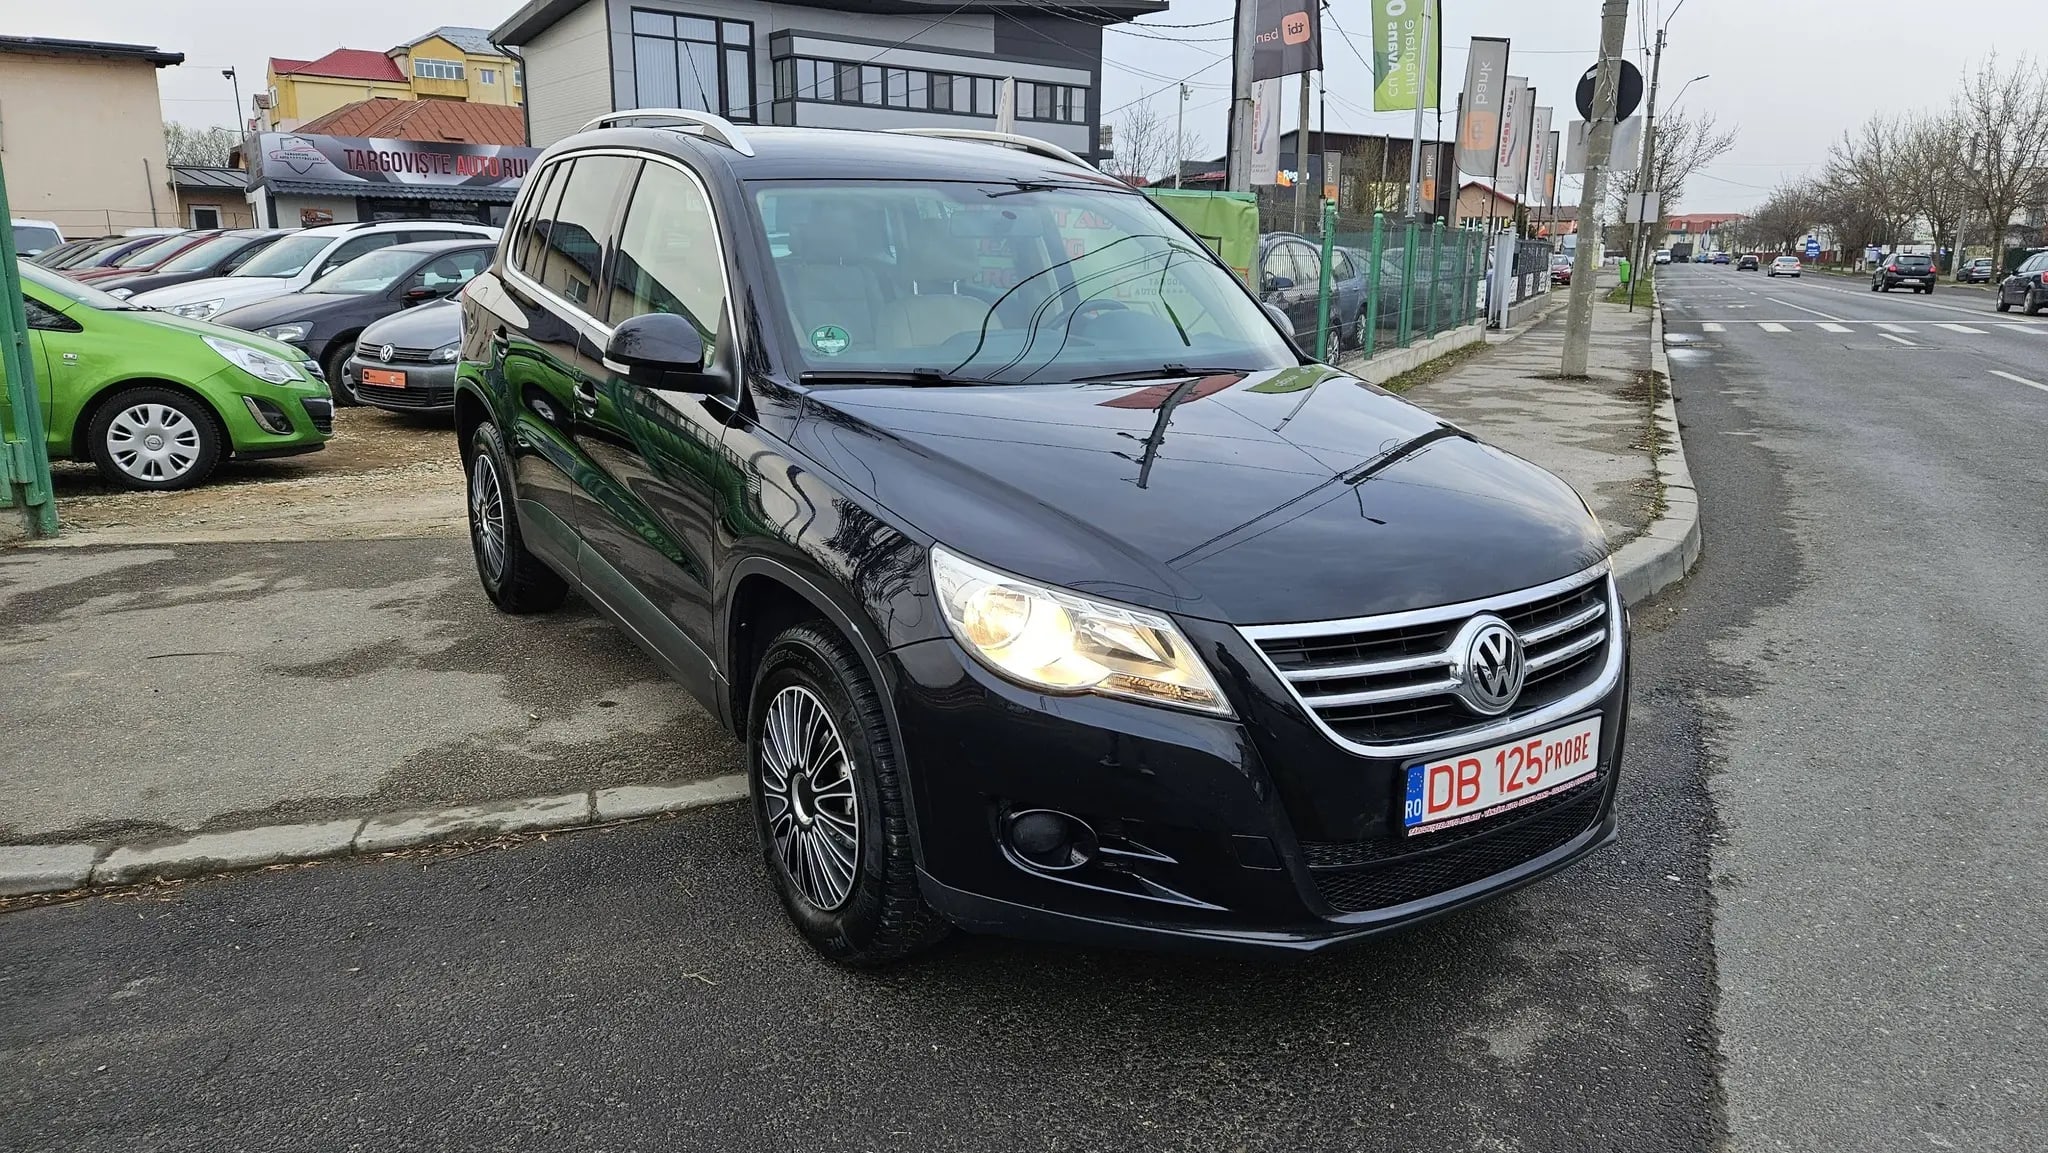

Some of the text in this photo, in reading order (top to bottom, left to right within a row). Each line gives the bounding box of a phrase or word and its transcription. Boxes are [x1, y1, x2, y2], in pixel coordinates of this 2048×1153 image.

[456, 154, 500, 177] AUTO
[824, 327, 836, 340] 4
[1469, 627, 1519, 703] VW
[1405, 798, 1422, 819] RO
[1428, 757, 1482, 815] DB
[1495, 739, 1543, 795] 125
[1544, 732, 1592, 775] PROBE
